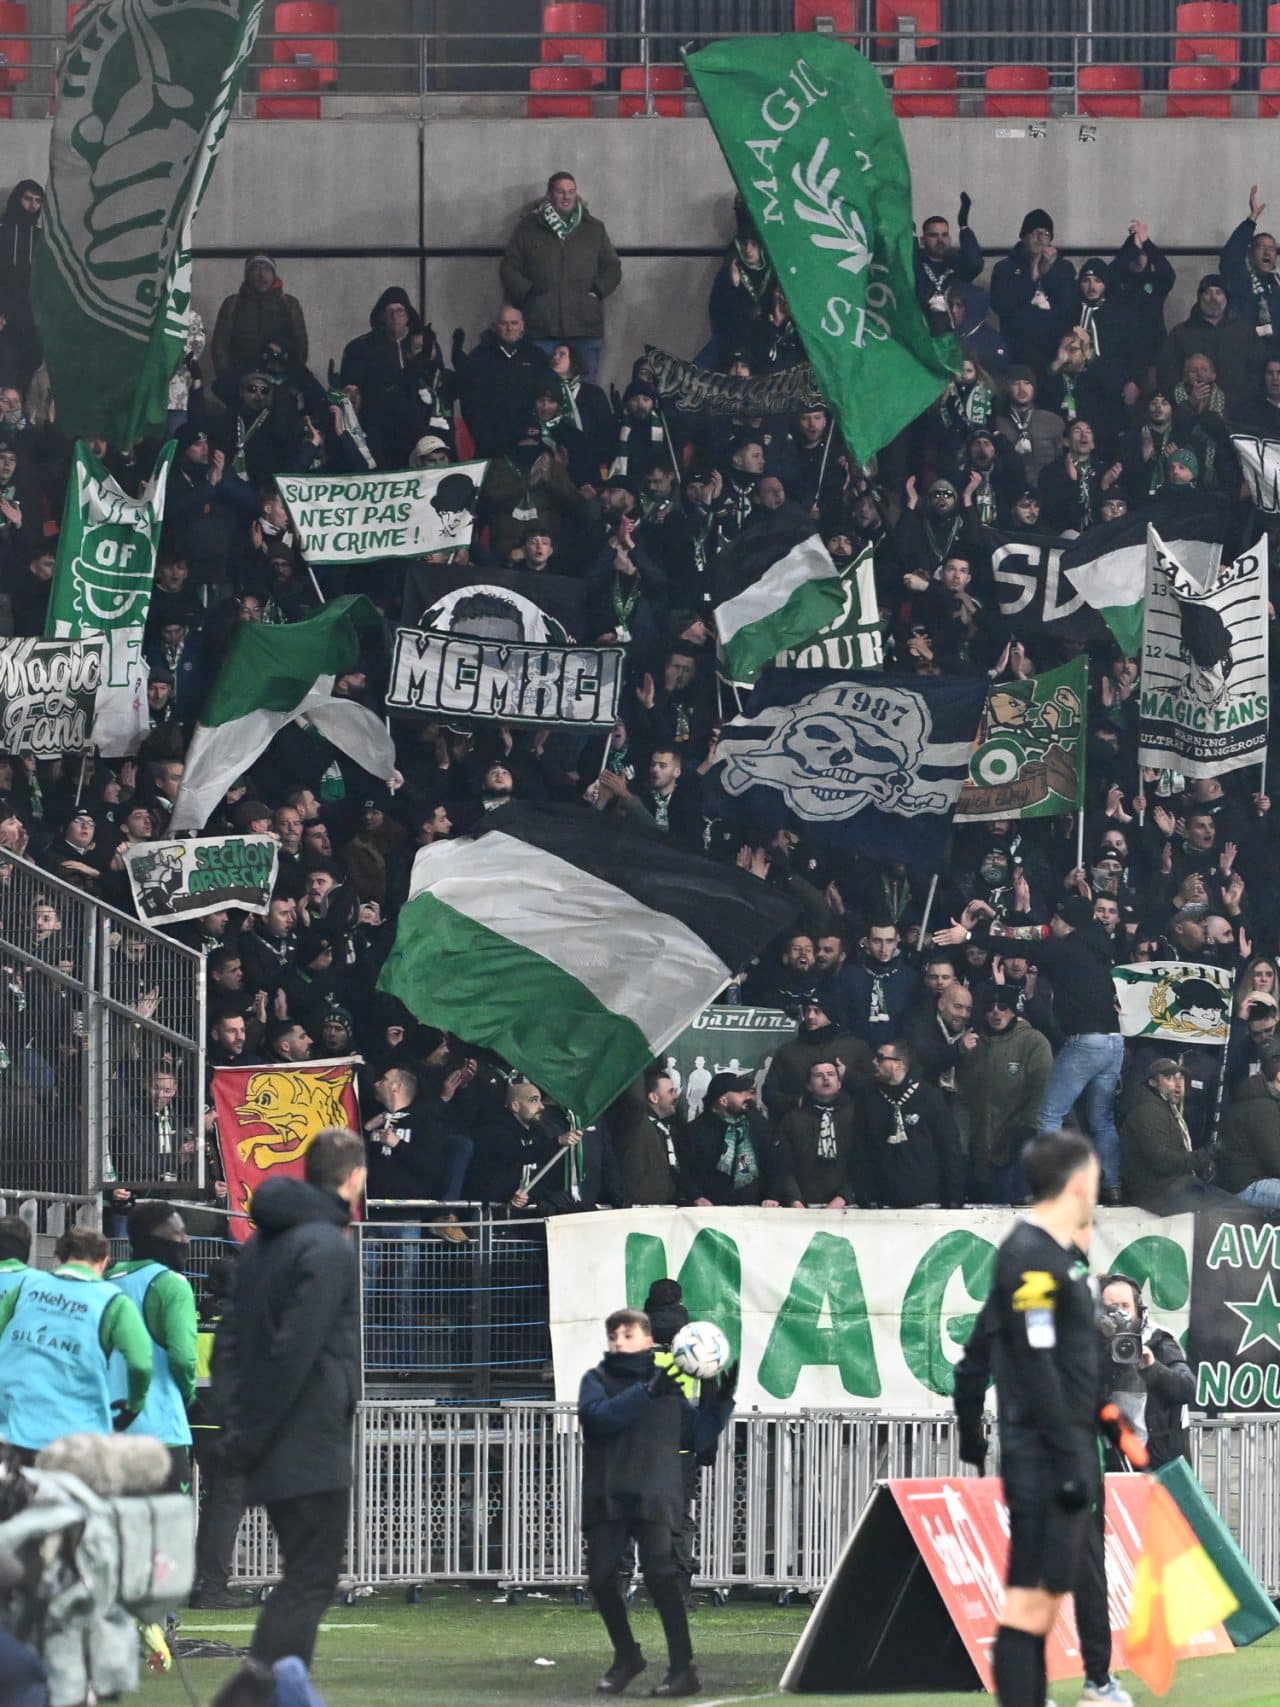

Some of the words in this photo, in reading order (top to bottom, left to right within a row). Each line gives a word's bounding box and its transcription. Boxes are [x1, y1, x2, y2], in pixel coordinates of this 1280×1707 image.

[286, 479, 425, 505] SUPPORTER
[363, 503, 412, 525] PAS
[95, 539, 137, 568] OF
[302, 533, 329, 553] UN
[332, 527, 406, 554] CRIME
[1151, 583, 1168, 597] 13
[1145, 646, 1162, 658] 12
[0, 636, 100, 706] Magic
[833, 688, 910, 726] 1987
[1141, 692, 1207, 730] MAGIC
[1214, 695, 1268, 731] FANS
[5, 698, 86, 754] Fans
[195, 838, 276, 870] SECTION
